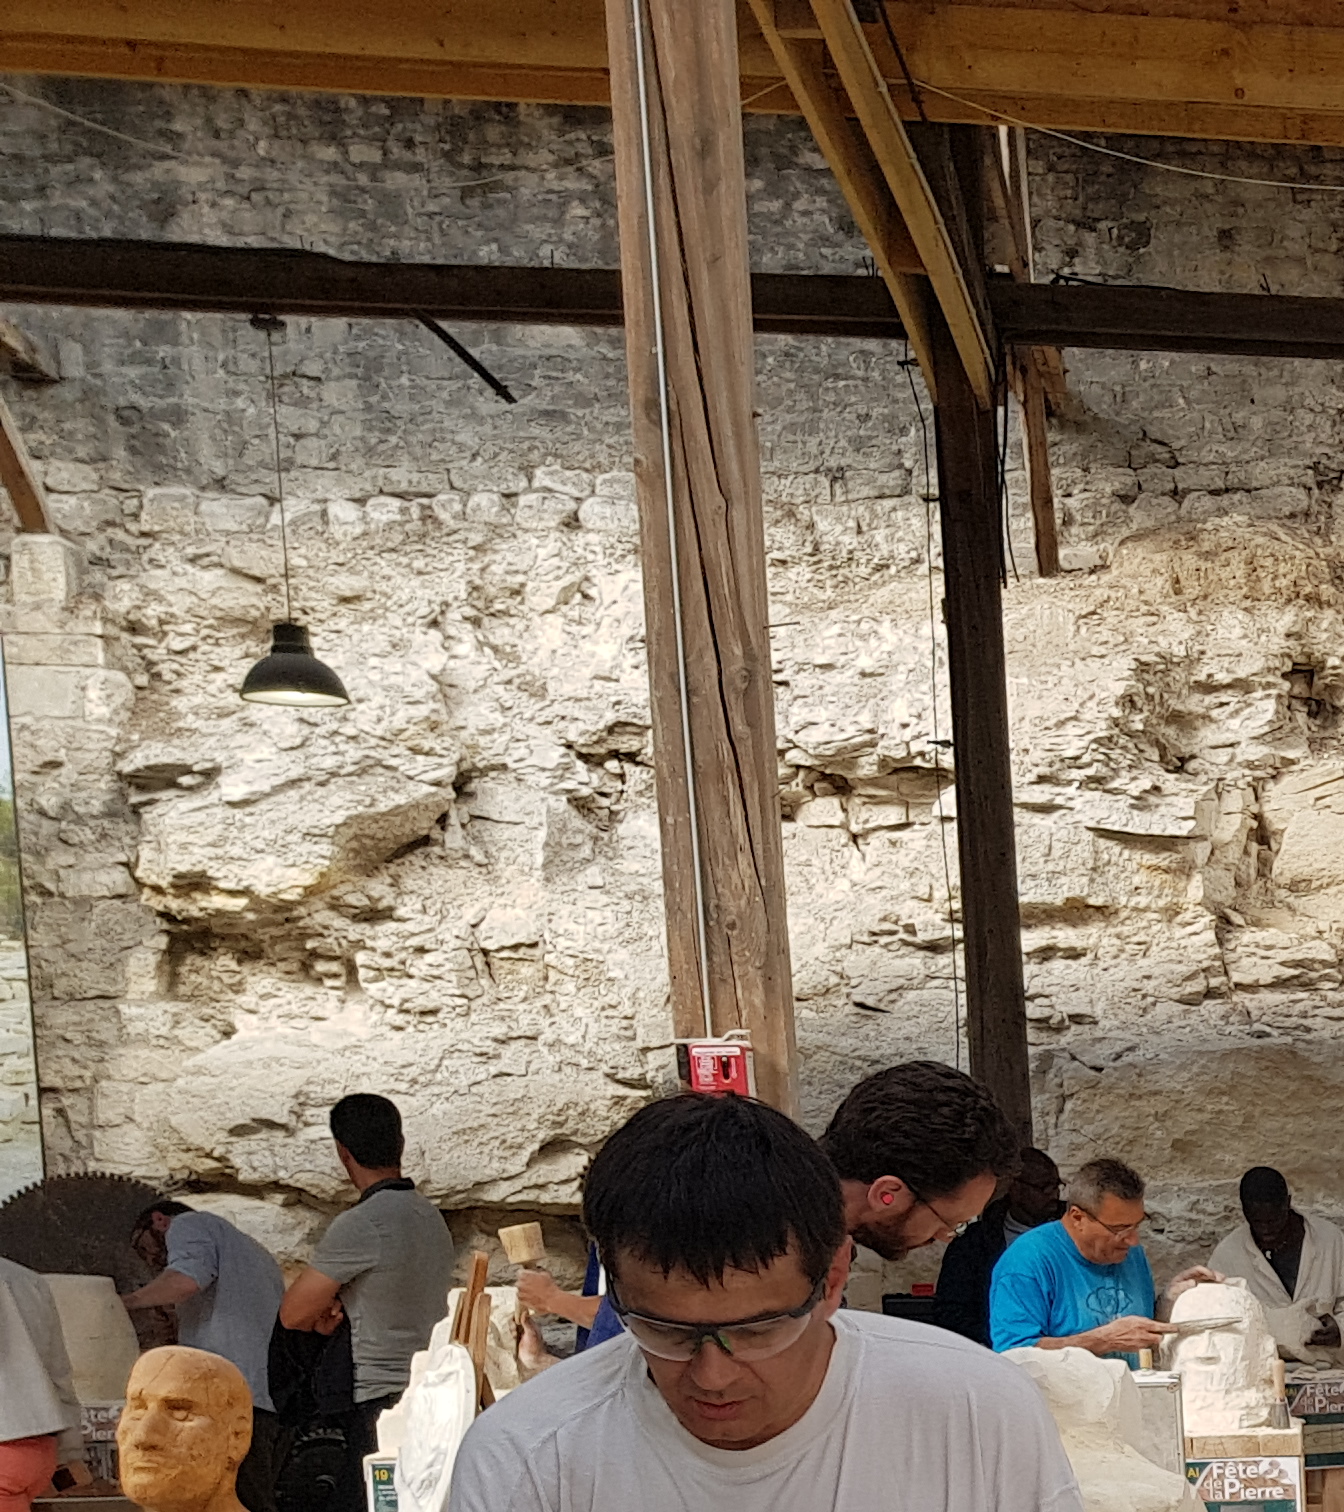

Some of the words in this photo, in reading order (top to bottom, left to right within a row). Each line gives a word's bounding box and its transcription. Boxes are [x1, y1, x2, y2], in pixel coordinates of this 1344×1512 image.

[1306, 1383, 1339, 1397] Fête
[374, 1469, 389, 1481] 19
[1212, 1461, 1259, 1479] Fête
[1203, 1478, 1222, 1490] de
[1223, 1478, 1284, 1499] Pierre
[1210, 1489, 1223, 1499] la
